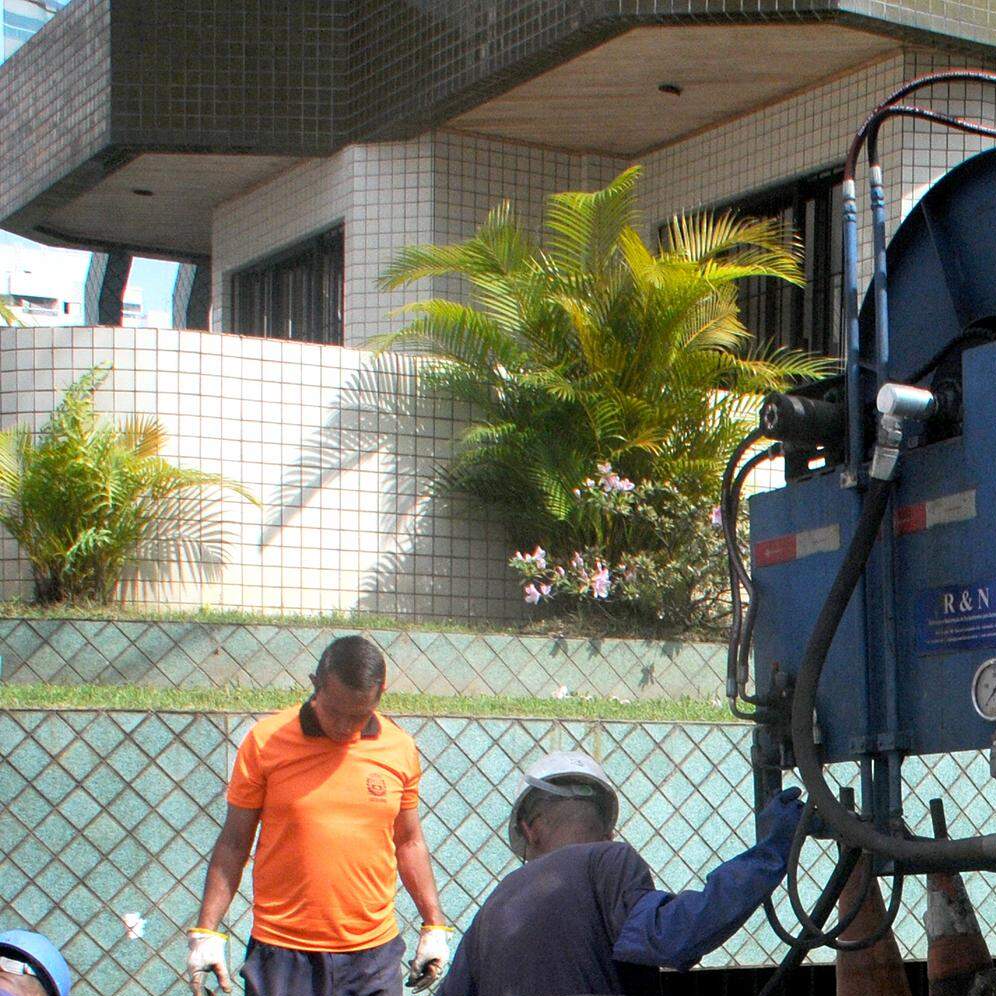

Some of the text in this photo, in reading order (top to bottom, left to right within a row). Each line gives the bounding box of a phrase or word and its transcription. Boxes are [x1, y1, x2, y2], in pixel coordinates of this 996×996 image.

[943, 587, 991, 615] R & N
